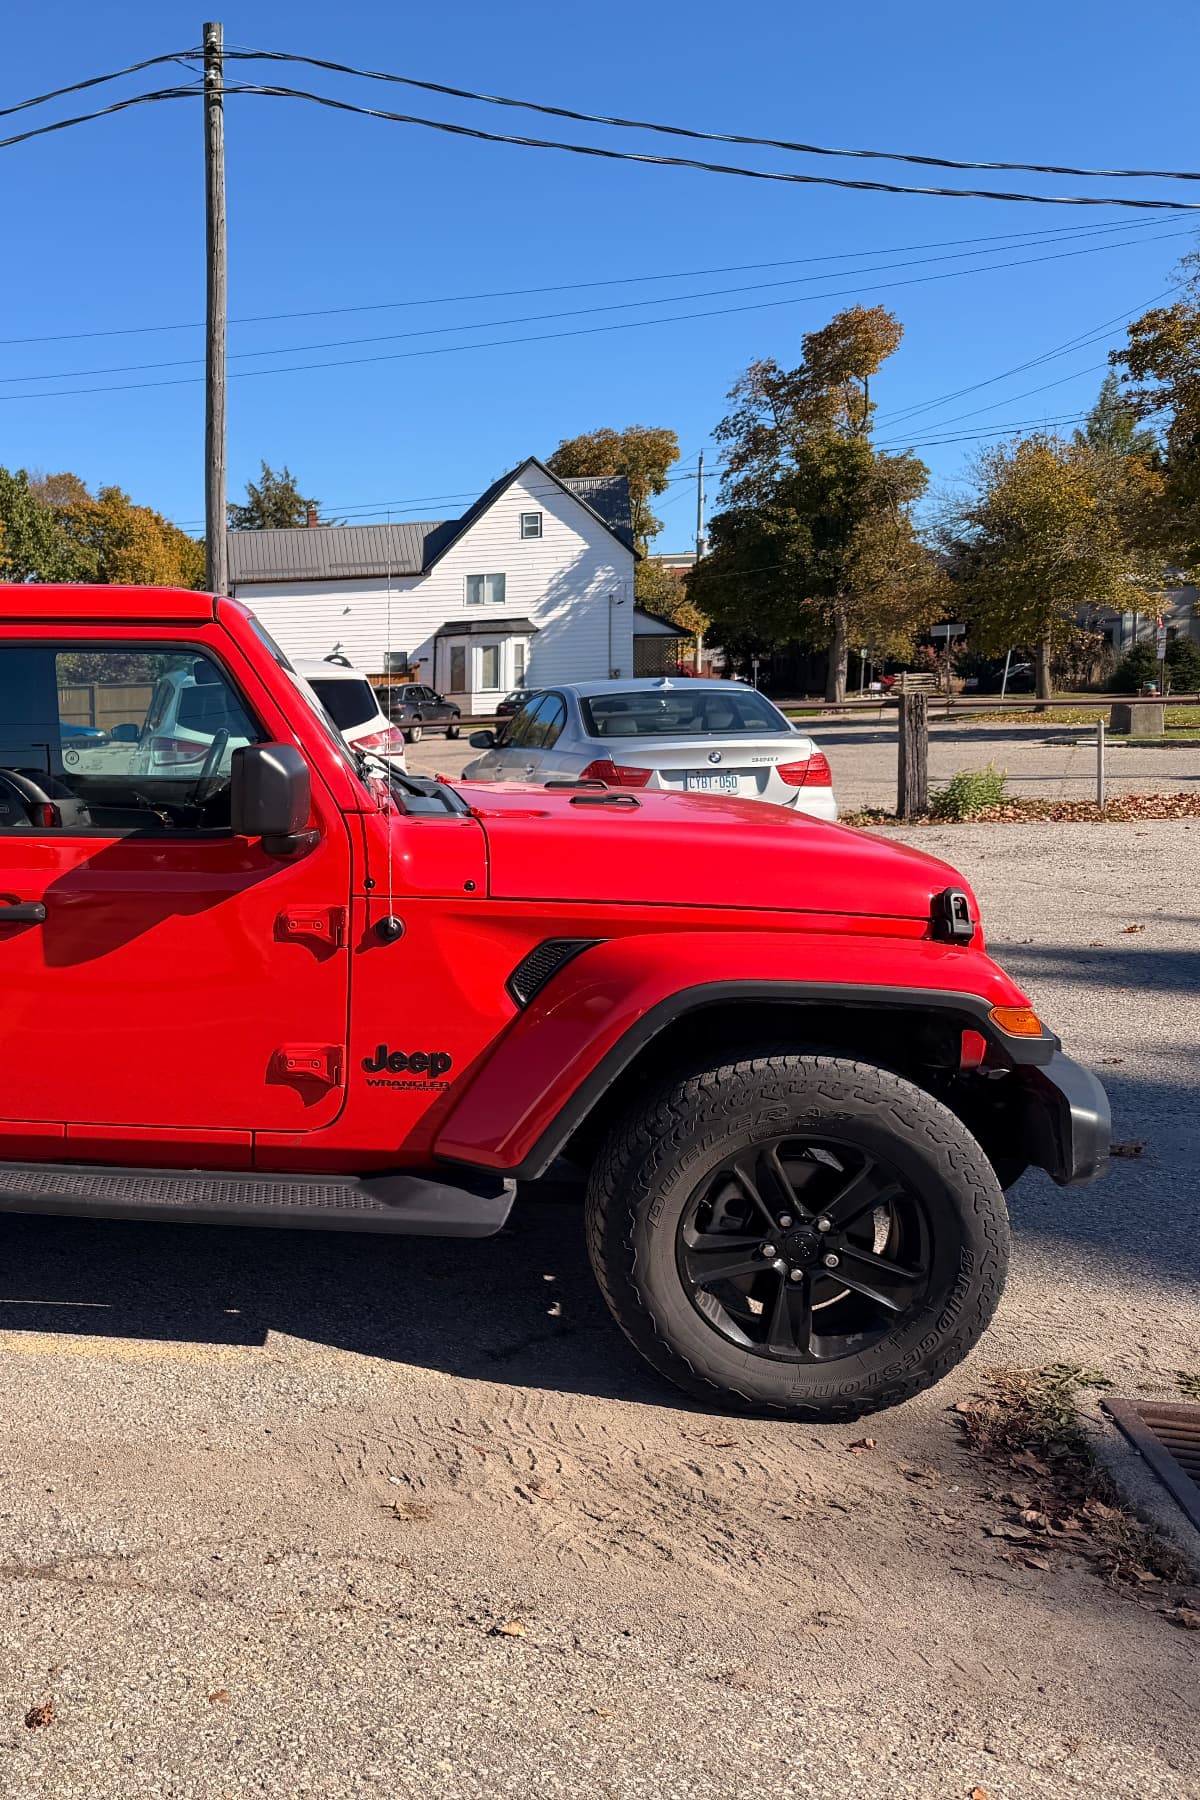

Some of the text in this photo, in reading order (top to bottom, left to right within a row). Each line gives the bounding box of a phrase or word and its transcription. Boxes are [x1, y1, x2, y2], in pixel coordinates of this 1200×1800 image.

[361, 1044, 452, 1078] Jeep
[365, 1079, 450, 1087] WRANGLER
[648, 1104, 789, 1229] DUELER
[791, 1246, 976, 1400] BRIDGESTONE
